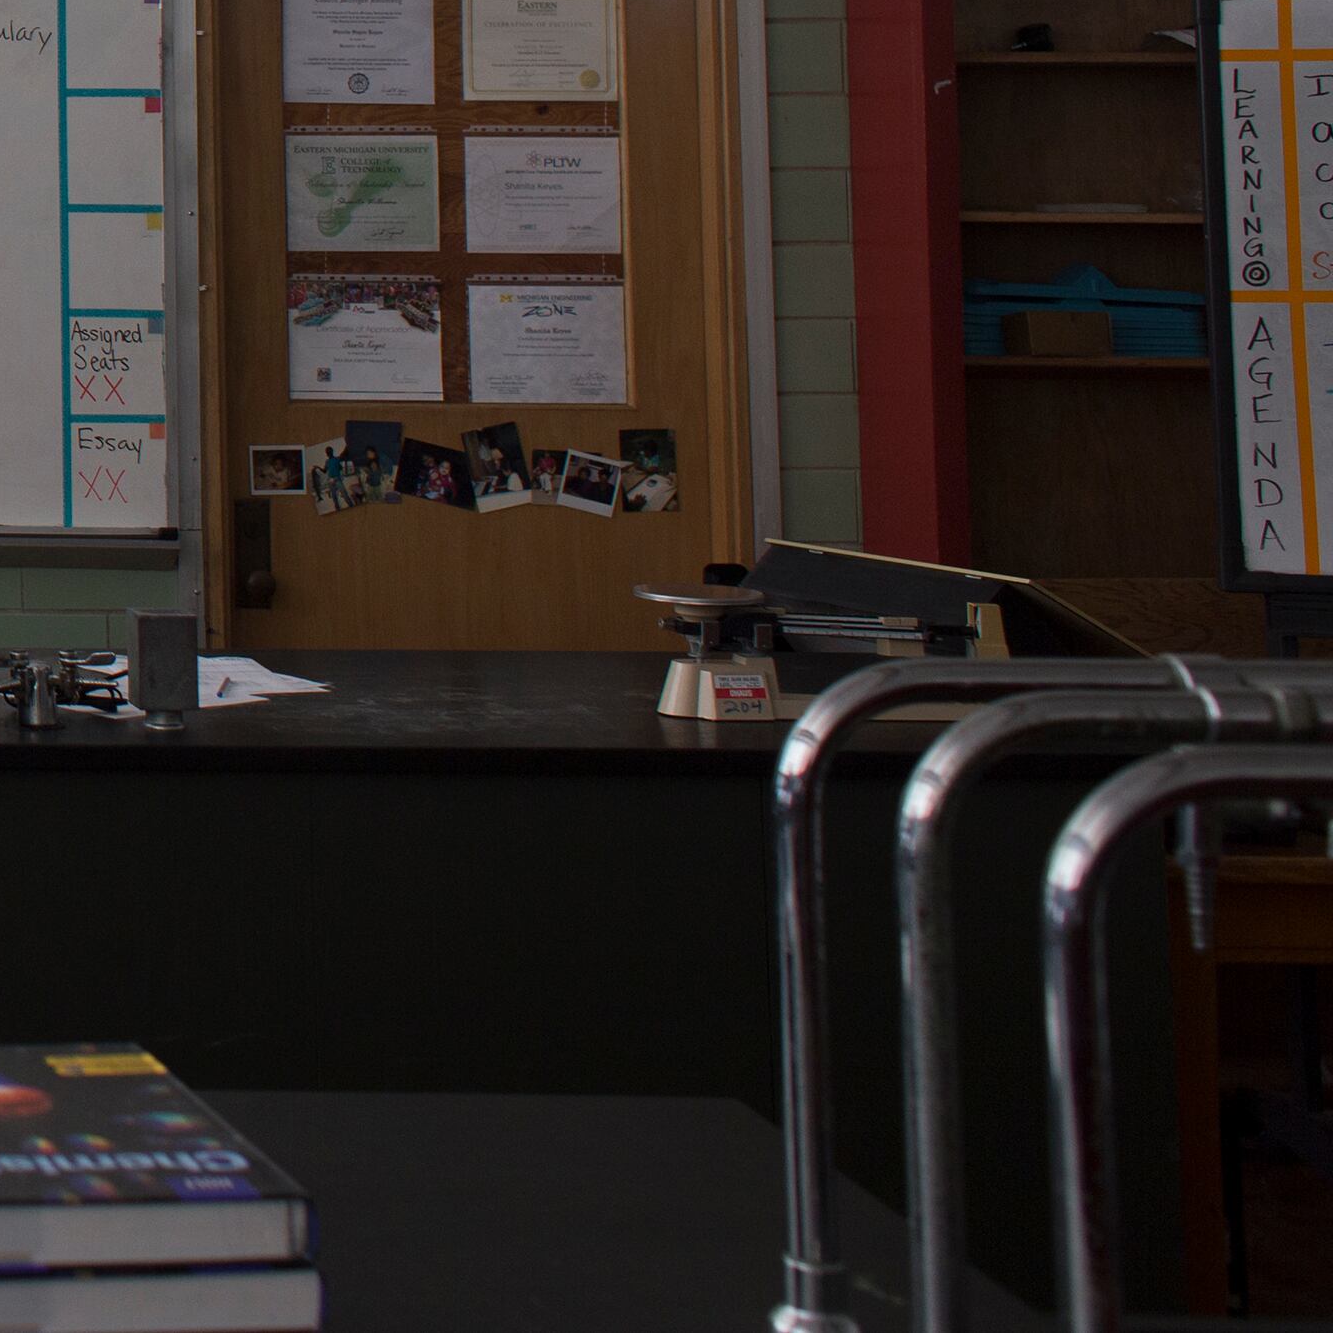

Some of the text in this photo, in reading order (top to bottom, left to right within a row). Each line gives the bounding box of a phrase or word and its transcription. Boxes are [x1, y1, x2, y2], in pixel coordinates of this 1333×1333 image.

[293, 145, 430, 154] EASTERN MICHIGAN UNIVERSITY
[543, 157, 582, 169] PLTW
[1232, 68, 1265, 259] LEARNING
[70, 320, 143, 355] Assigned
[74, 345, 130, 373] Seats
[78, 427, 143, 464] Essay
[1247, 315, 1286, 552] AGENDA
[723, 699, 762, 714] 204
